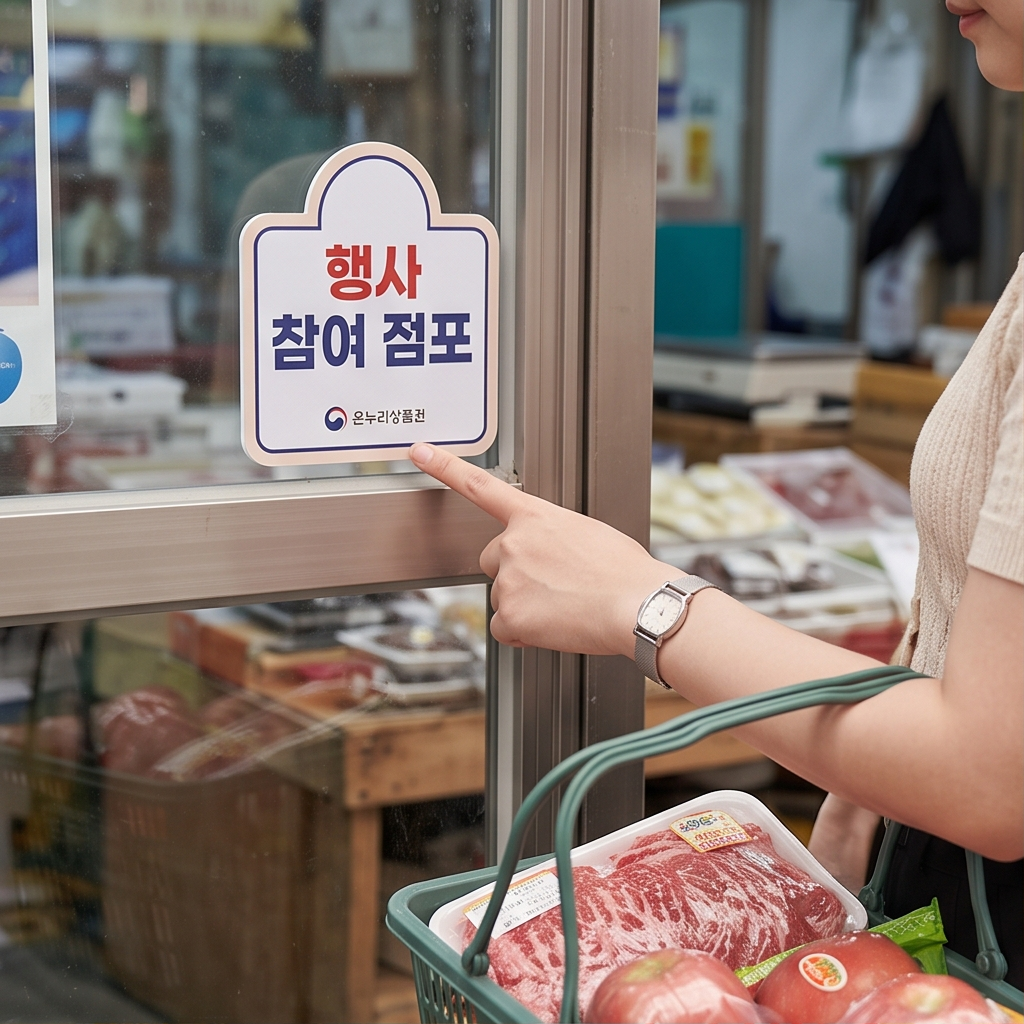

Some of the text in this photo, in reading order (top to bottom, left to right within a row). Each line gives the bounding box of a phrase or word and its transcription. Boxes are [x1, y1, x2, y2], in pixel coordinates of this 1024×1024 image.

[326, 244, 422, 301] 행사
[272, 312, 472, 370] 참여 점포
